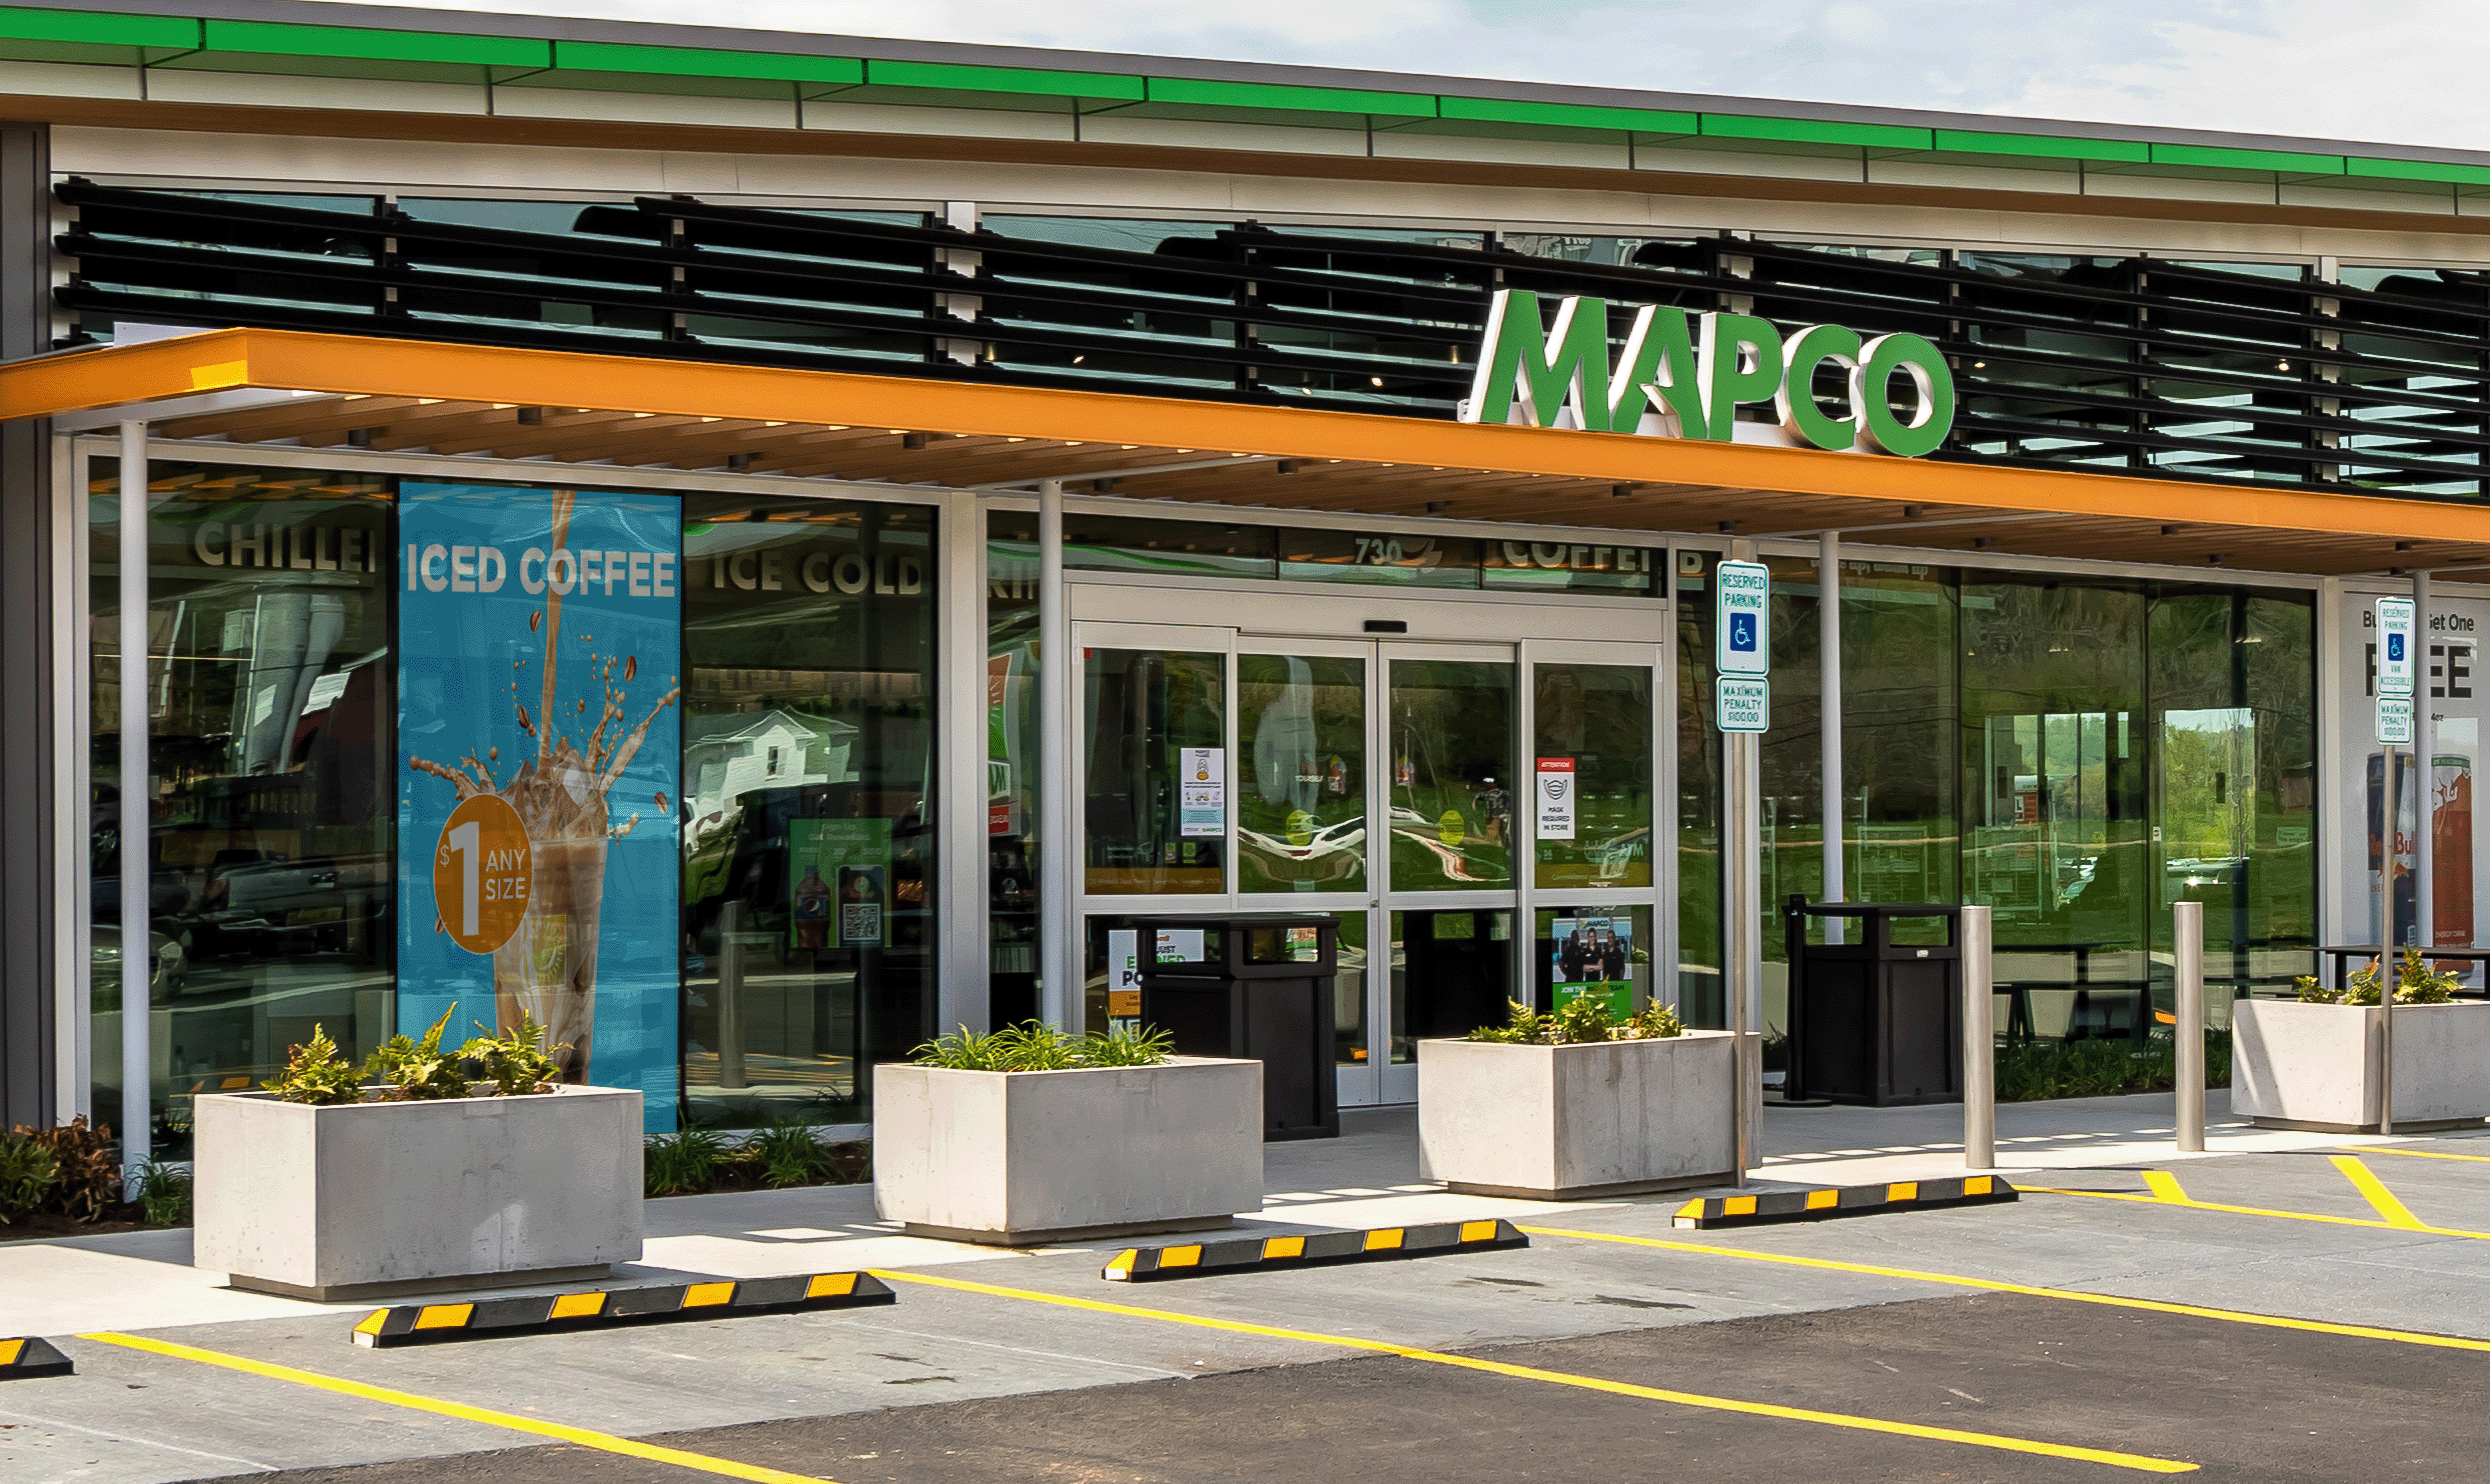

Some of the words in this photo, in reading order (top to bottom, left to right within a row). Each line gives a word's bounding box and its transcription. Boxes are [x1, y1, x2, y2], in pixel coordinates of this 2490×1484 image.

[1464, 289, 1955, 457] MAPCO
[1355, 538, 1402, 565] 730
[407, 543, 506, 593] ICED
[520, 547, 676, 598] COFFEE
[712, 552, 783, 591] ICE
[802, 552, 922, 595] COLD
[1722, 573, 1767, 590] RESERVED
[1724, 592, 1762, 608] PARKING
[2449, 613, 2474, 631] One
[2365, 642, 2472, 698] FEE
[1723, 686, 1763, 697] MAXIMUM
[1723, 698, 1762, 710] PENALTY
[2381, 715, 2408, 726] PENALTY
[485, 848, 526, 872] ANY
[485, 876, 526, 900] SIZE
